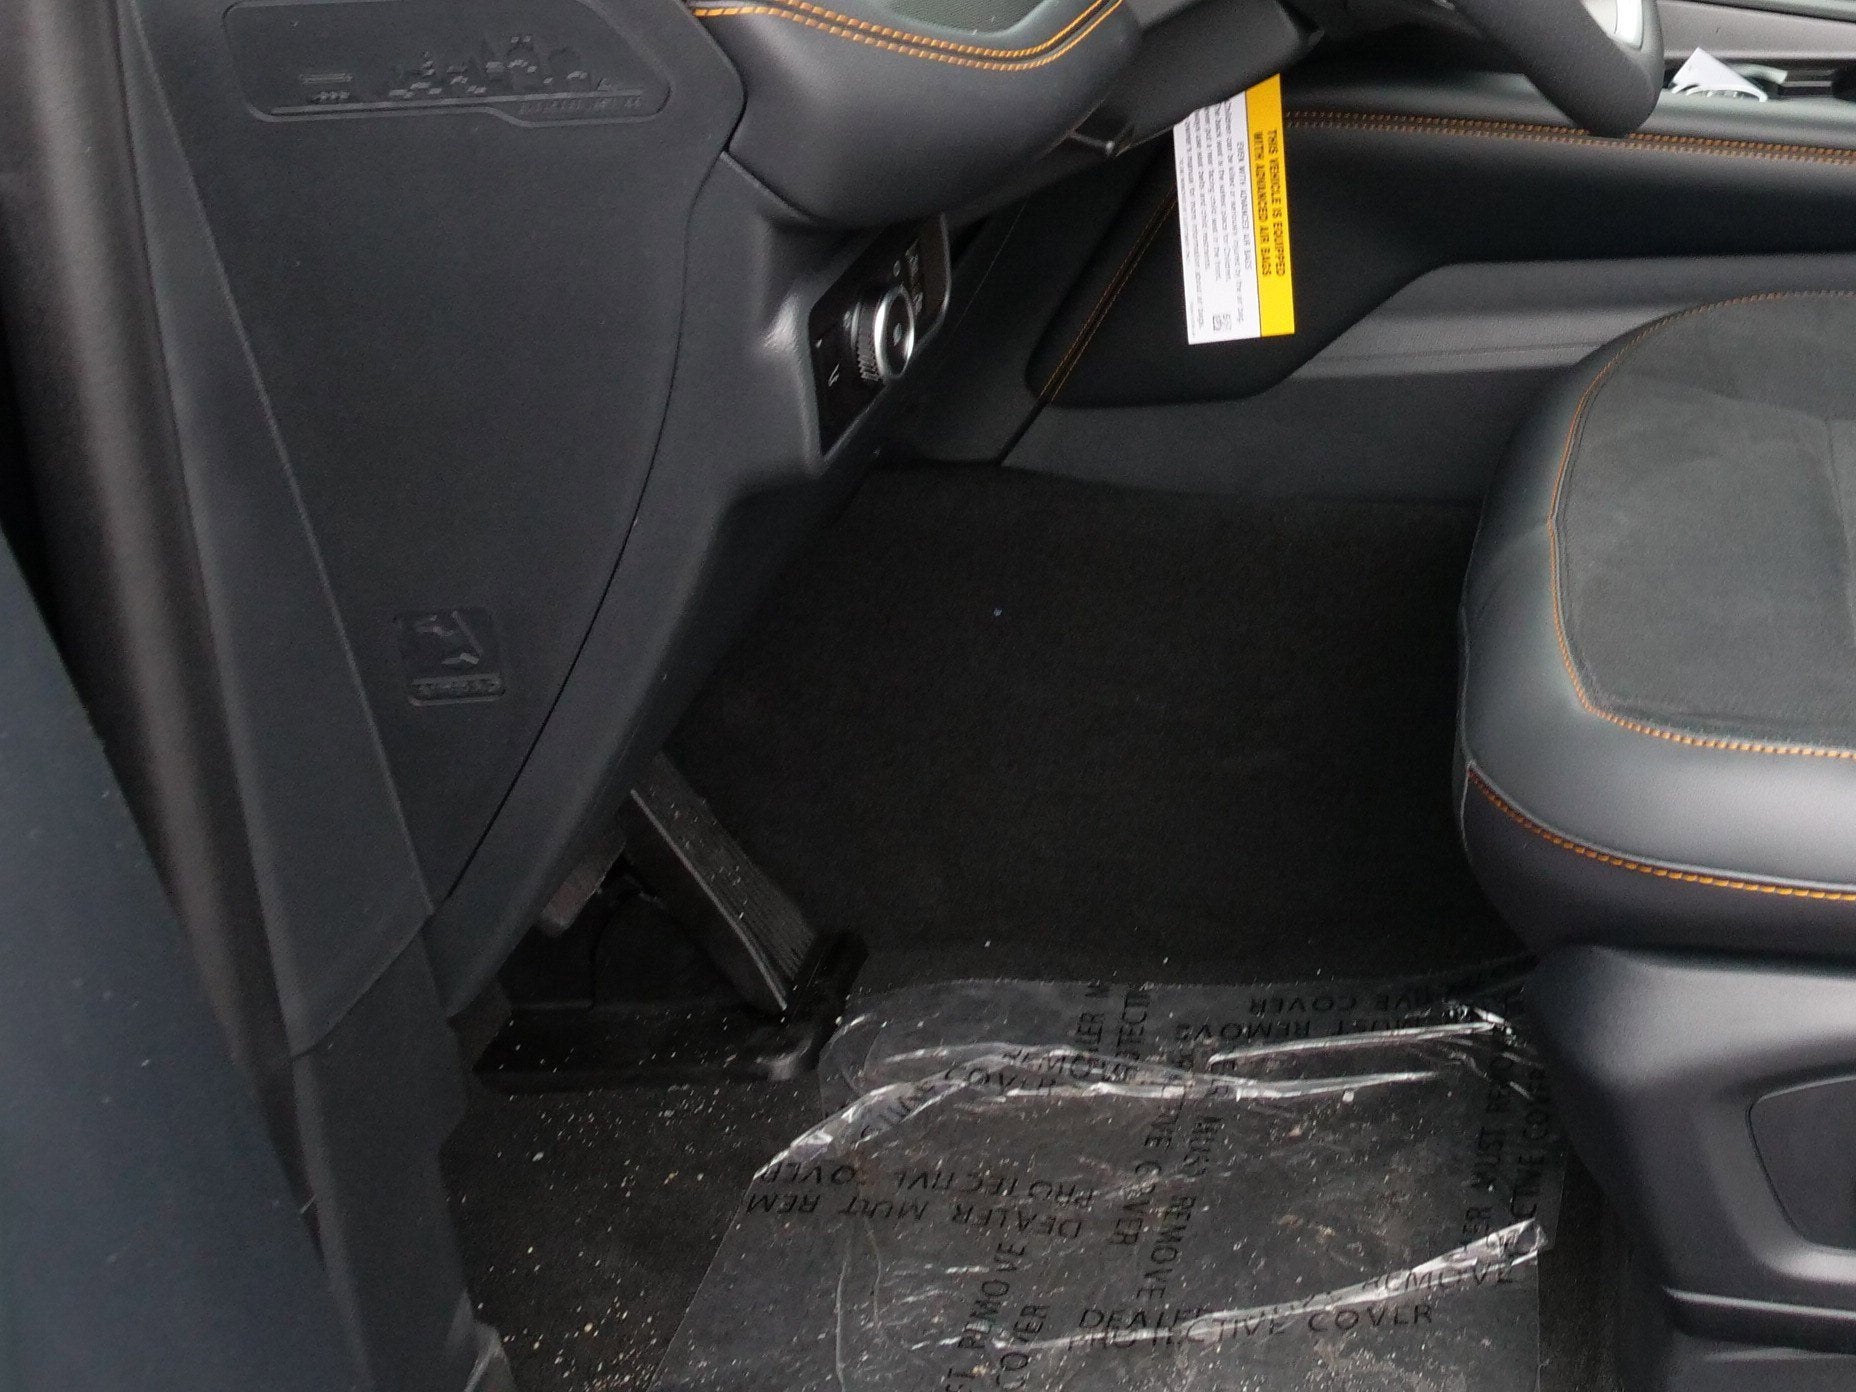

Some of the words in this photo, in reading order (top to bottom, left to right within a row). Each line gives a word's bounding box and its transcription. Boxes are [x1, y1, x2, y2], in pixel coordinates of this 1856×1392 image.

[1252, 131, 1264, 160] WITH
[1267, 129, 1278, 154] THIS
[1254, 163, 1268, 220] ADVANCED
[1268, 158, 1281, 205] VEHICLE
[1272, 207, 1282, 218] IS
[1258, 225, 1269, 243] AIR
[1272, 221, 1285, 276] EQUIPPED
[1260, 247, 1271, 276] BAGS
[1136, 1195, 1198, 1301] REMOVE
